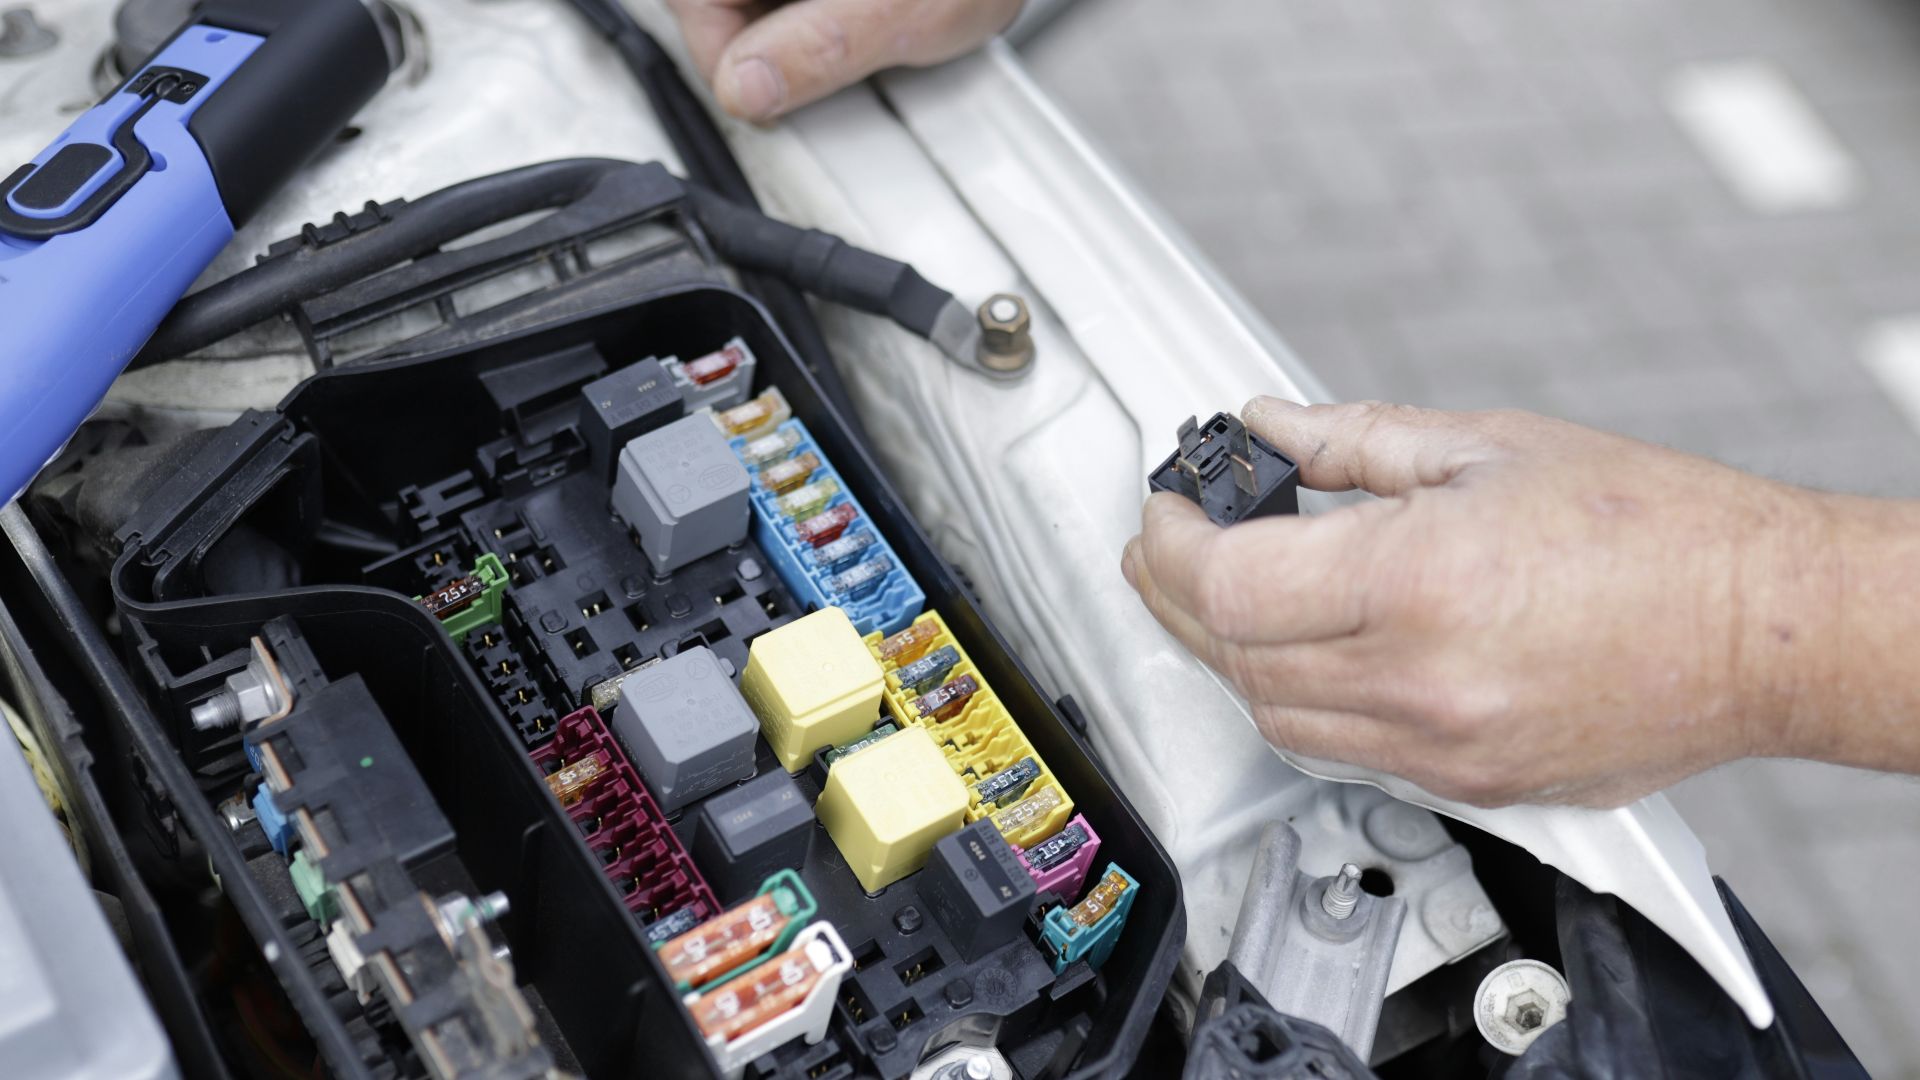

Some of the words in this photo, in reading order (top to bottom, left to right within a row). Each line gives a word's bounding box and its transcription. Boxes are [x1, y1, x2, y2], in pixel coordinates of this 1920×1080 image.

[439, 585, 466, 603] 7.5s
[897, 632, 915, 645] 5s
[911, 656, 938, 674] 15s
[559, 770, 577, 785] 5s
[992, 770, 1018, 789] 15s
[1012, 802, 1040, 820] 25s
[1039, 839, 1065, 859] 15s
[1086, 892, 1104, 913] 5s
